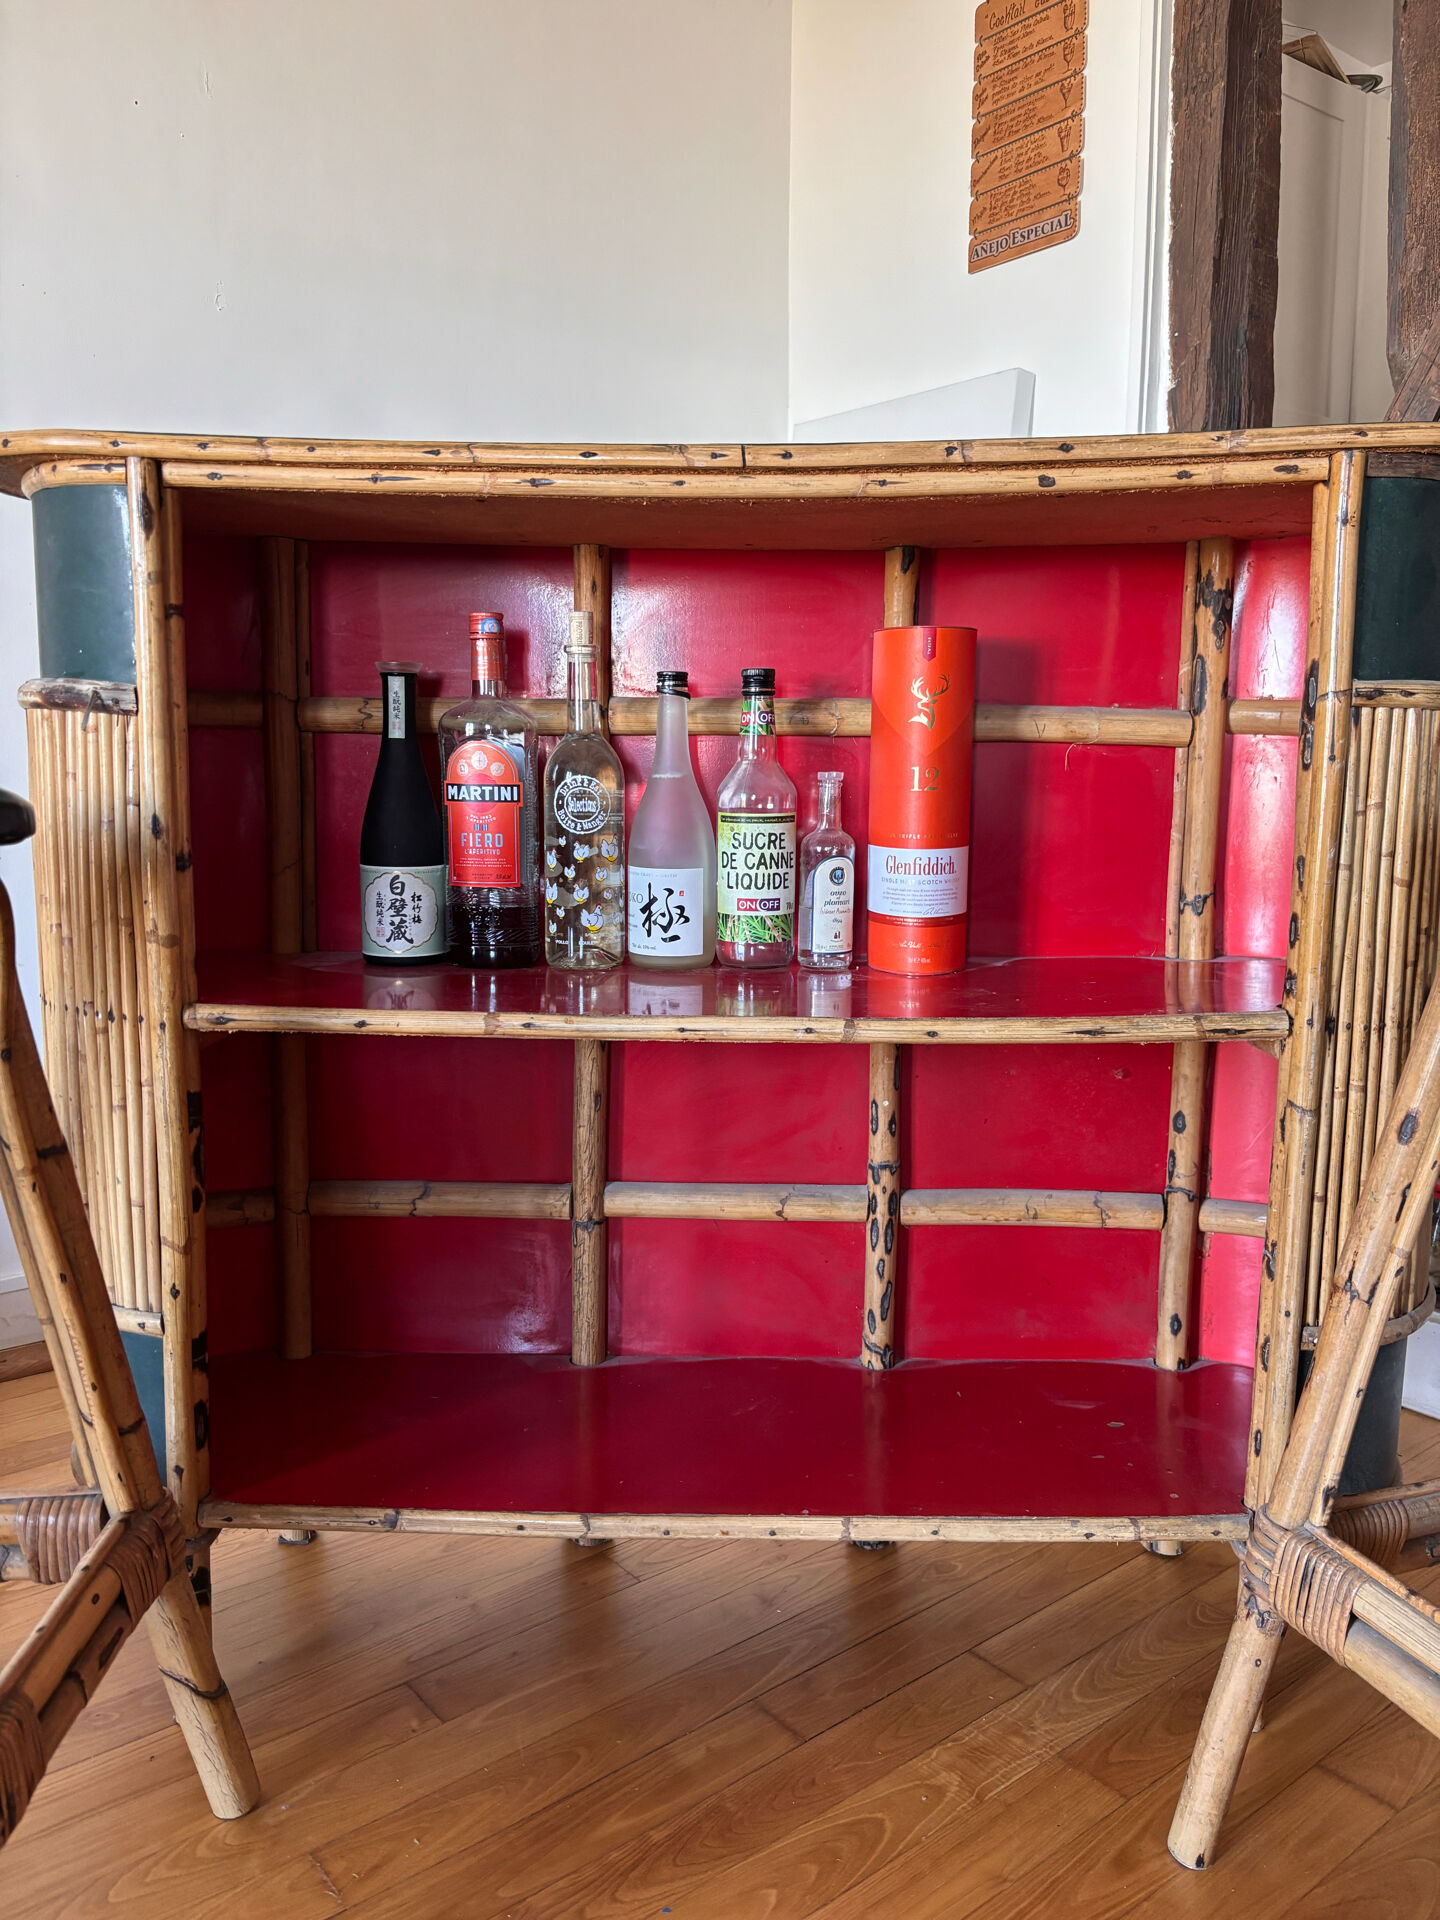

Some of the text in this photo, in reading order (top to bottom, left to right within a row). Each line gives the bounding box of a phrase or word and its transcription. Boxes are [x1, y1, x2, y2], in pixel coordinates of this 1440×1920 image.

[972, 212, 1072, 260] AÑEJO ESPECIAL
[741, 713, 754, 723] ON
[910, 766, 939, 791] 12
[447, 785, 518, 801] MARTINI
[461, 832, 503, 848] FIERO
[731, 832, 786, 850] SUCRE
[721, 851, 794, 870] DE CANNE
[885, 855, 955, 876] Glenfiddich
[726, 871, 790, 890] LIQUIDE
[385, 874, 415, 944] 白壁蔵
[639, 881, 690, 944] 極
[738, 900, 779, 909] ON OFF
